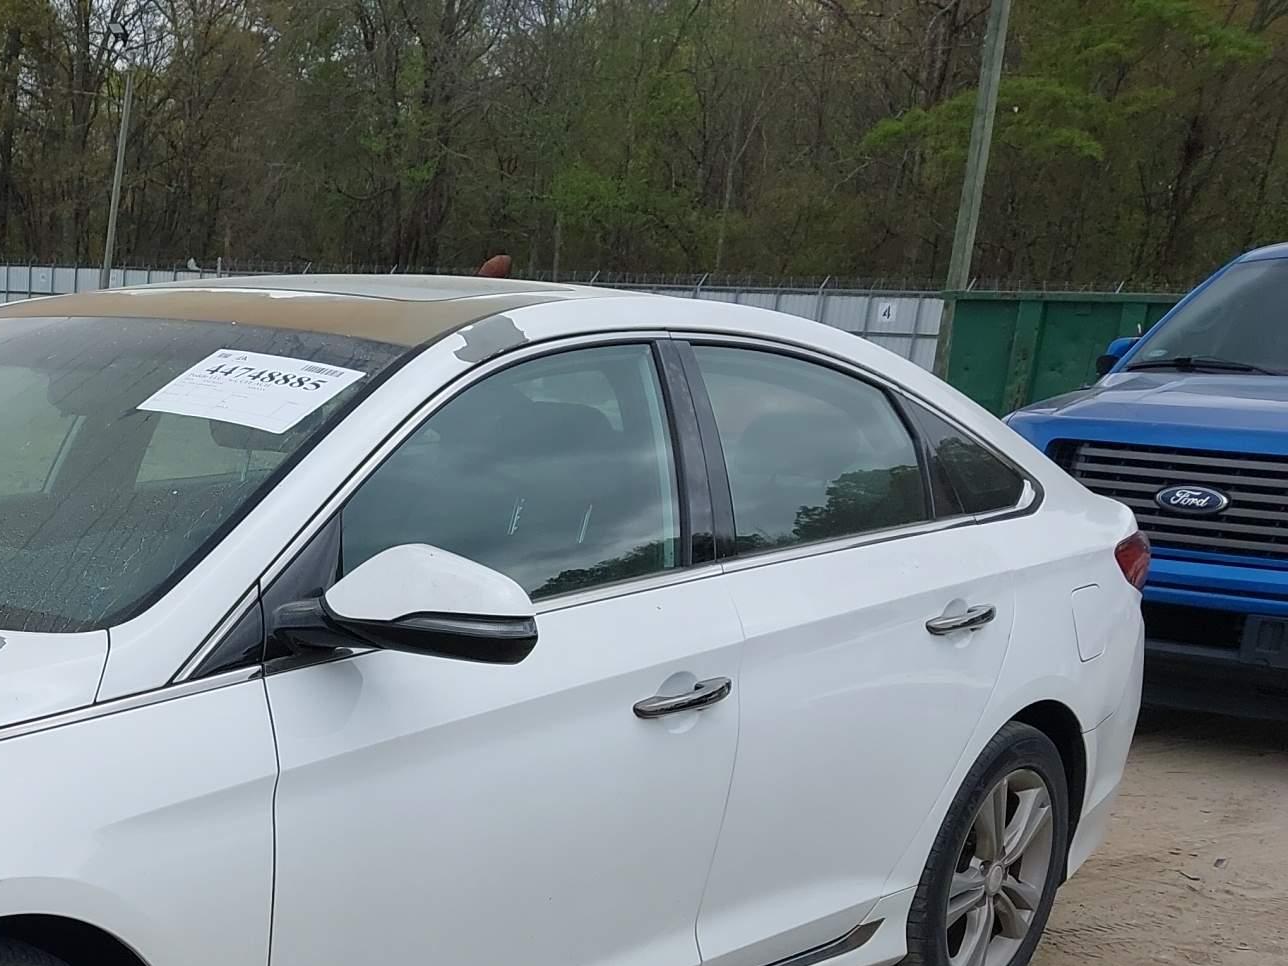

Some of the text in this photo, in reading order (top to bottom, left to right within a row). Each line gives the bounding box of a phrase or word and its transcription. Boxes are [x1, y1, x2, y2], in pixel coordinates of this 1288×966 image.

[882, 303, 891, 319] 4
[206, 363, 329, 392] 44748885
[1170, 489, 1210, 508] Ford
